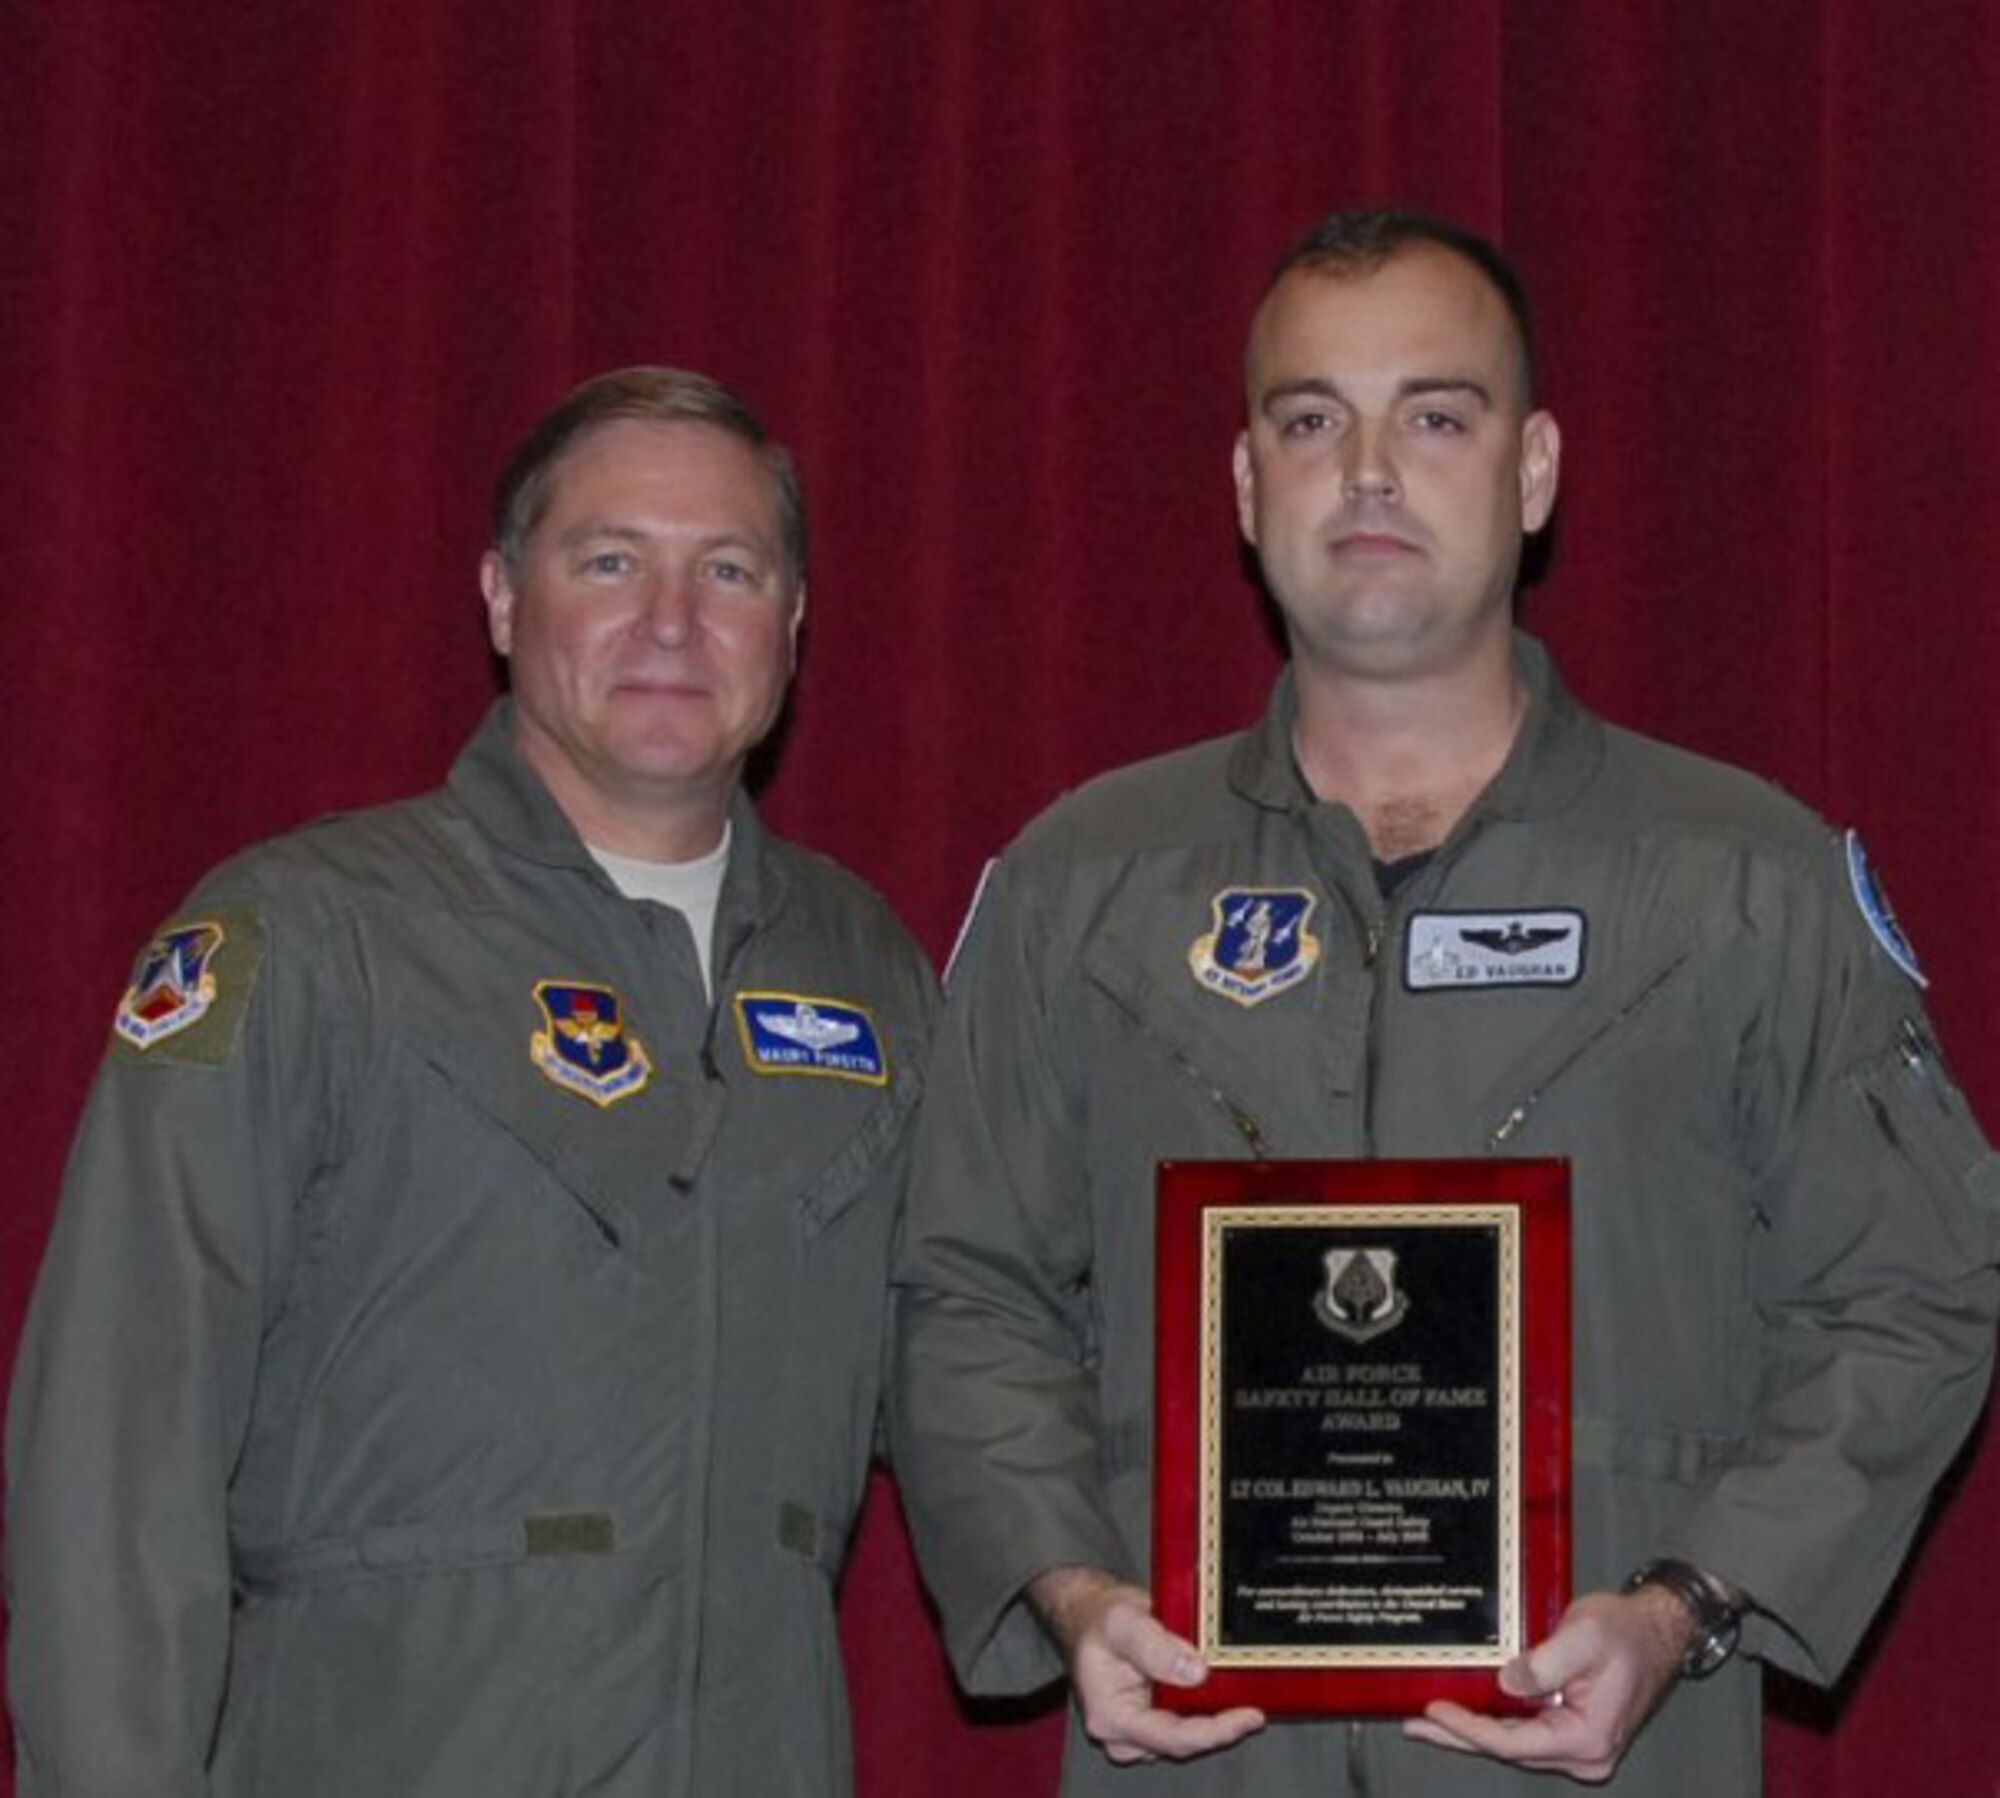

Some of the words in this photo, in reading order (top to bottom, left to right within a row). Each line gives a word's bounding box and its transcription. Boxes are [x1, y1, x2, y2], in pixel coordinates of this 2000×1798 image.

[1455, 965, 1479, 979] ED
[1486, 963, 1567, 979] VAUGHAN
[1302, 1364, 1339, 1384] AIR
[1344, 1364, 1421, 1384] FORCE
[1388, 1388, 1421, 1408] OF
[1320, 1412, 1402, 1431] AWARD
